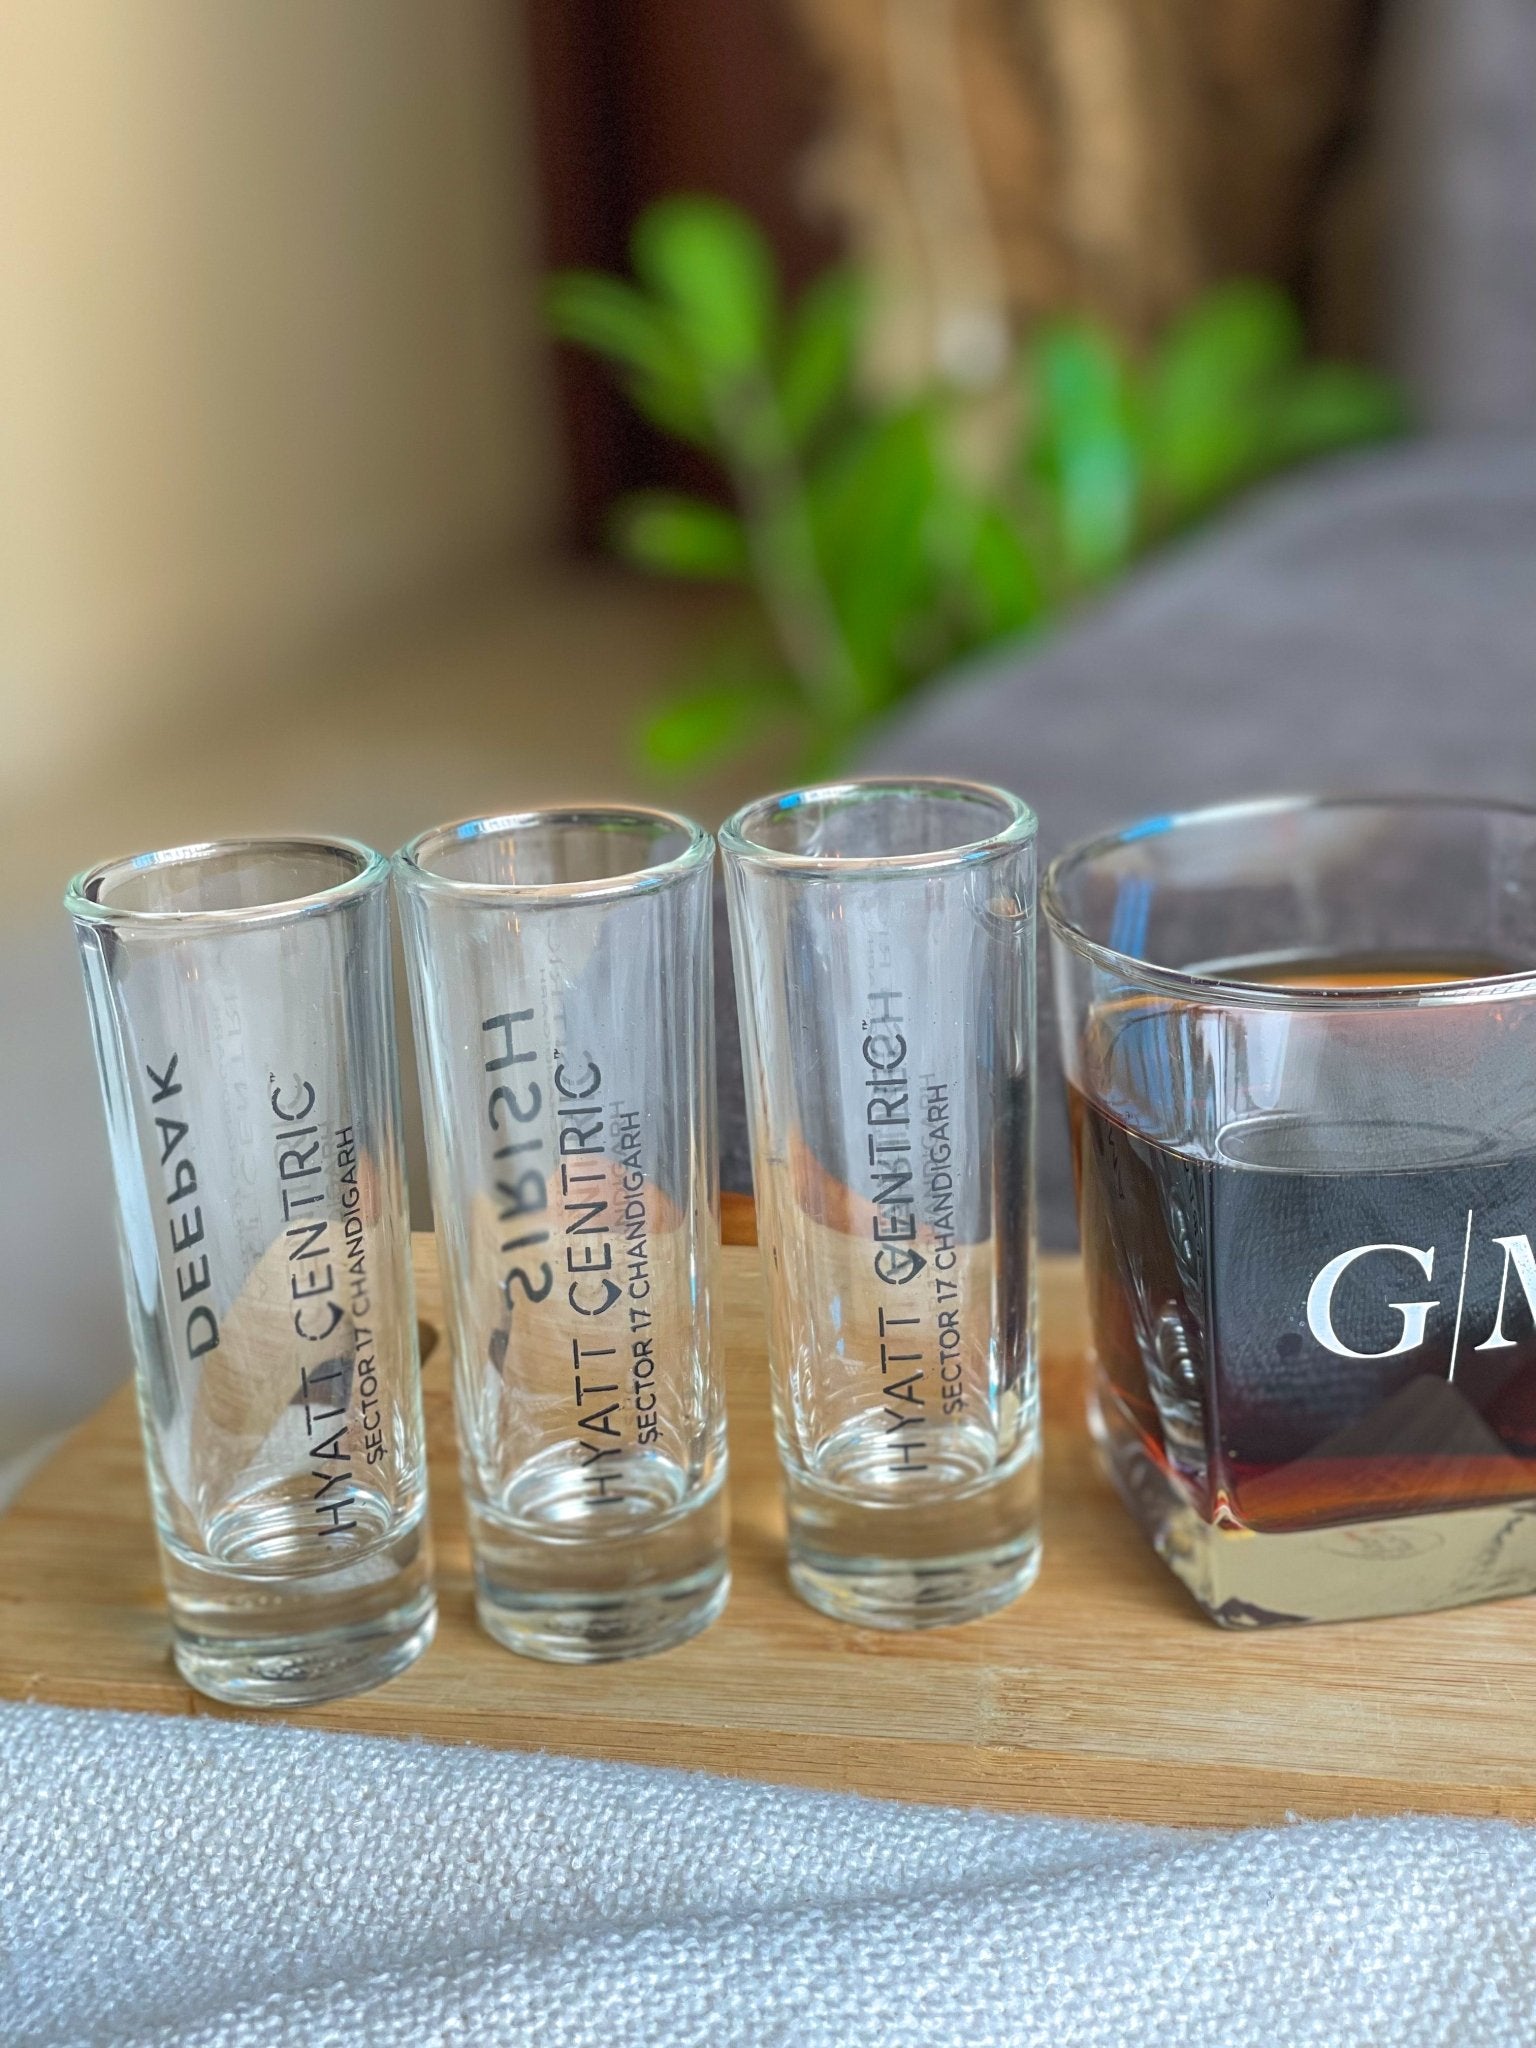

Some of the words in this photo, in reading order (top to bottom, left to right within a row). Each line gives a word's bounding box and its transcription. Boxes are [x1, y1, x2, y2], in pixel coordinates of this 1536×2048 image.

[335, 1125, 371, 1318] CHANDIGARH
[619, 1110, 650, 1298] CHANDIGARH
[926, 1082, 958, 1273] CHANDIGARH
[355, 1327, 374, 1353] 17
[630, 1307, 651, 1333] 17
[936, 1277, 959, 1304] 17
[357, 1360, 387, 1466] SECTOR
[573, 1338, 624, 1506] HYATT
[632, 1337, 659, 1446] SECTOR
[879, 1306, 928, 1473] HYATT
[937, 1306, 964, 1417] SECTOR
[300, 1366, 358, 1537] HYATT
